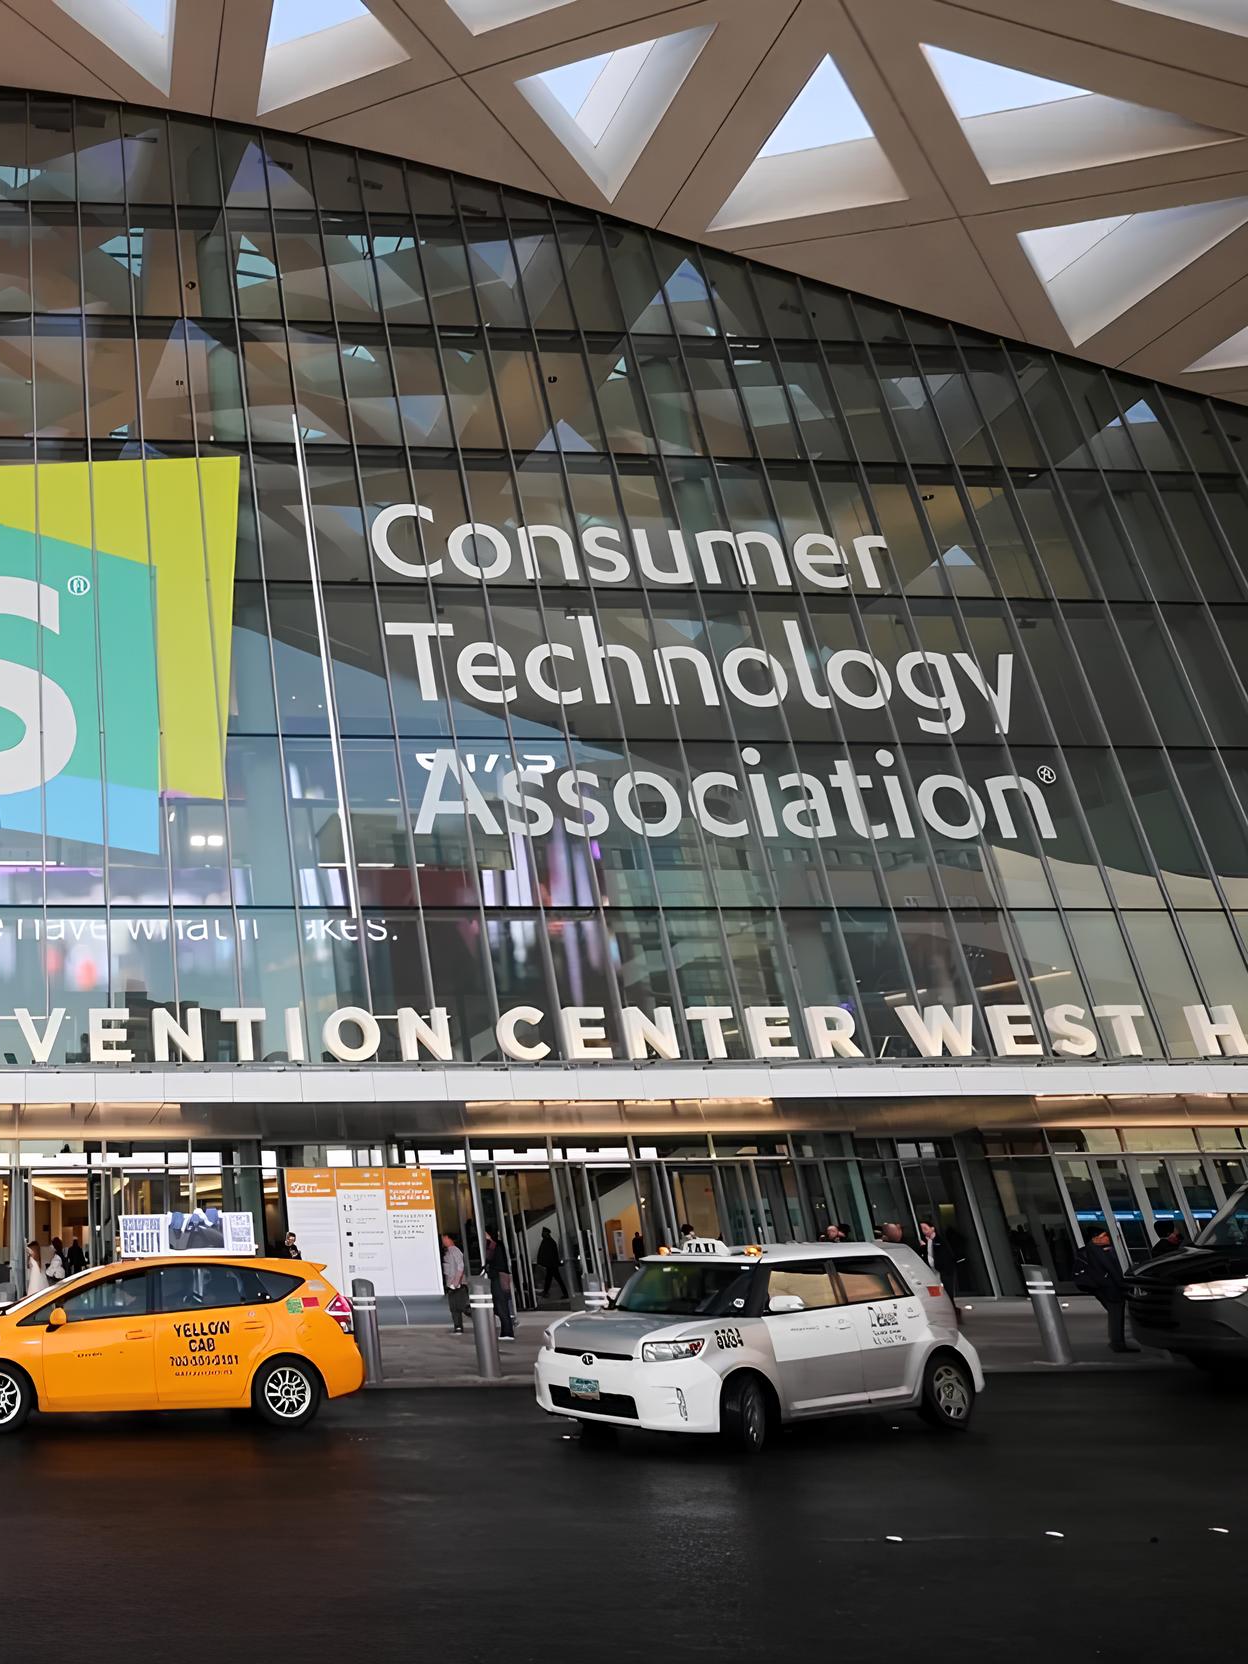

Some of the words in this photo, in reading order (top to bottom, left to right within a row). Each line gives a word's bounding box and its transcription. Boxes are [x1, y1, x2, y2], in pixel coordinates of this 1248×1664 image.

[371, 503, 887, 589] Consumer
[384, 615, 1013, 735] Technology
[496, 1005, 858, 1062] CENTER
[894, 1003, 1145, 1058] WEST
[687, 1242, 716, 1254] TAXI
[189, 1338, 216, 1353] CAB
